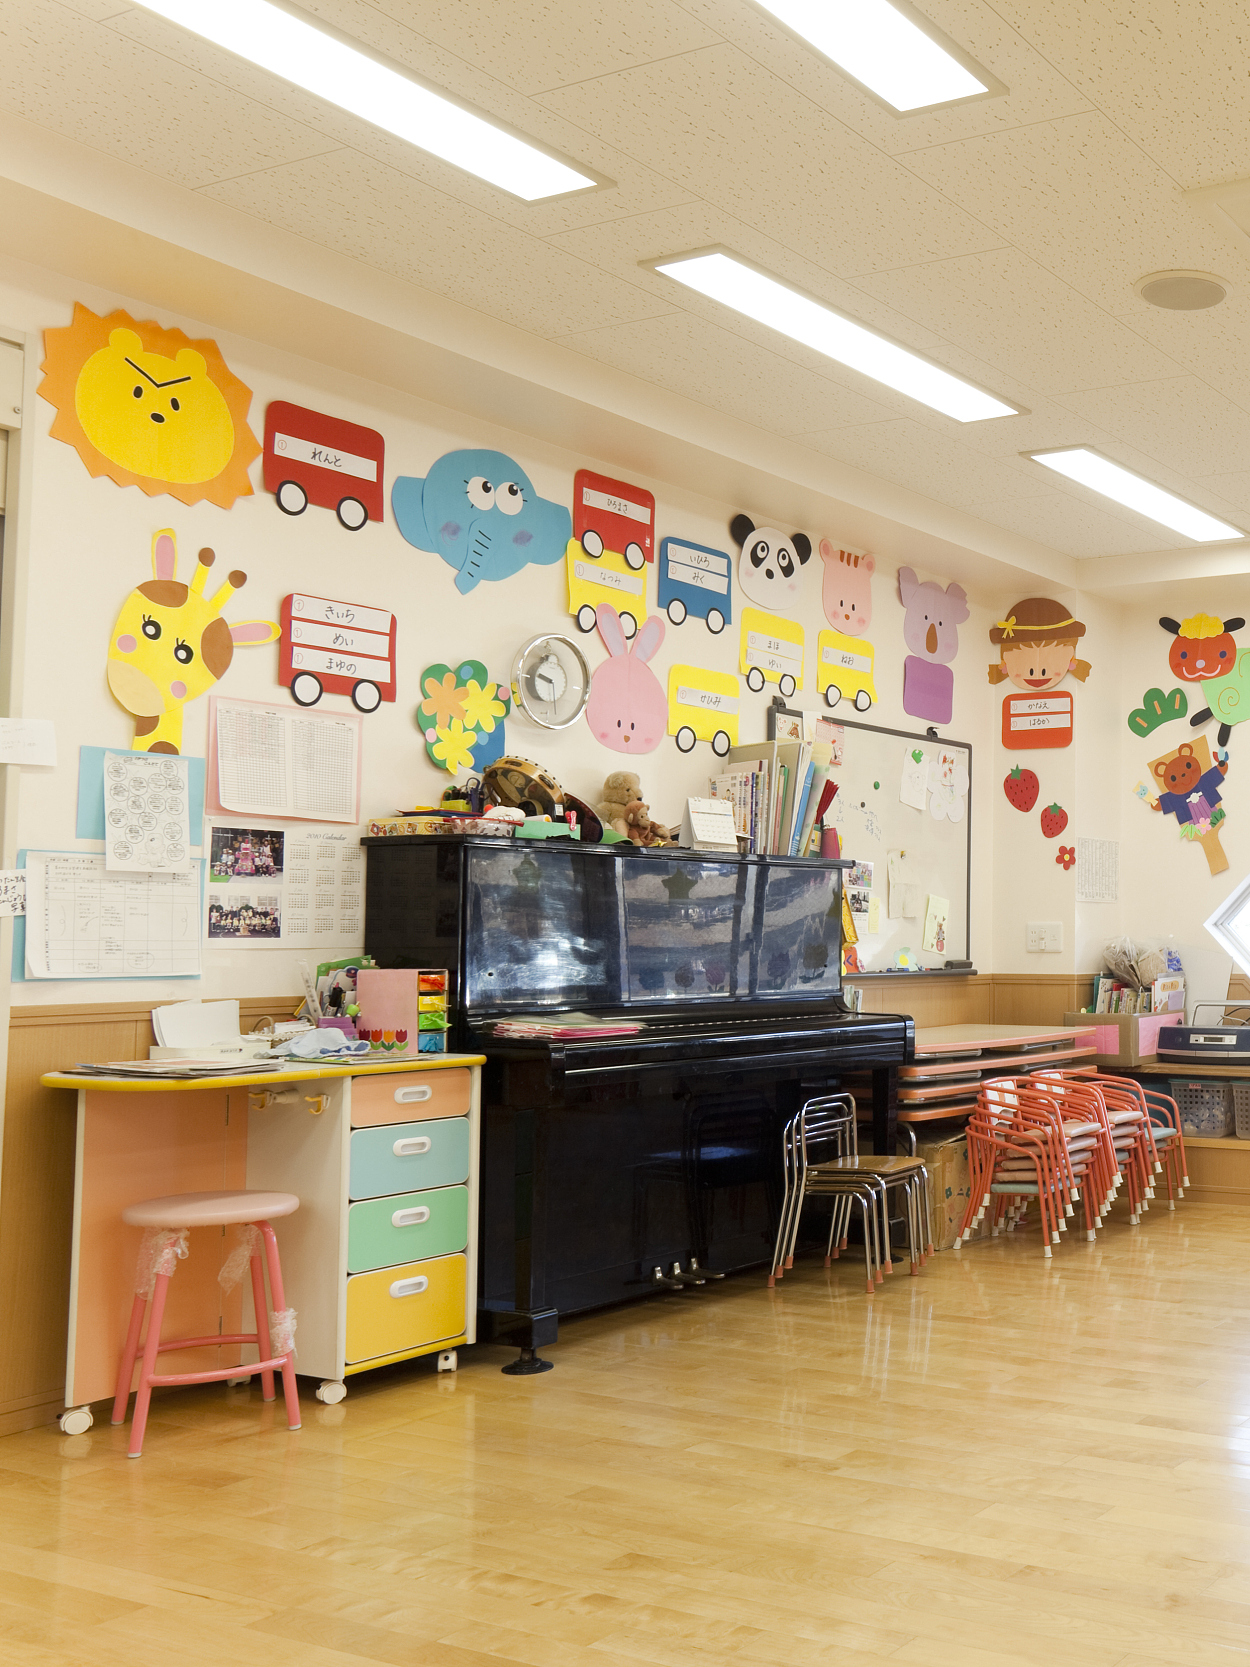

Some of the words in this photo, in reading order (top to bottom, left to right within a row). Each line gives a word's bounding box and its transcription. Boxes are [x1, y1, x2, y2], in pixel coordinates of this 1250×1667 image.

[311, 447, 342, 467] れんと
[606, 498, 628, 514] ひろまさ
[599, 571, 622, 586] なつみ
[692, 571, 705, 585] みく
[325, 605, 355, 624] きいち
[332, 633, 354, 646] めい
[767, 640, 780, 651] まほ
[325, 658, 357, 675] まゆの
[768, 658, 782, 669] ゆい
[1027, 701, 1050, 710] かなえ
[1029, 717, 1050, 727] はるか
[322, 833, 348, 841] Calendar
